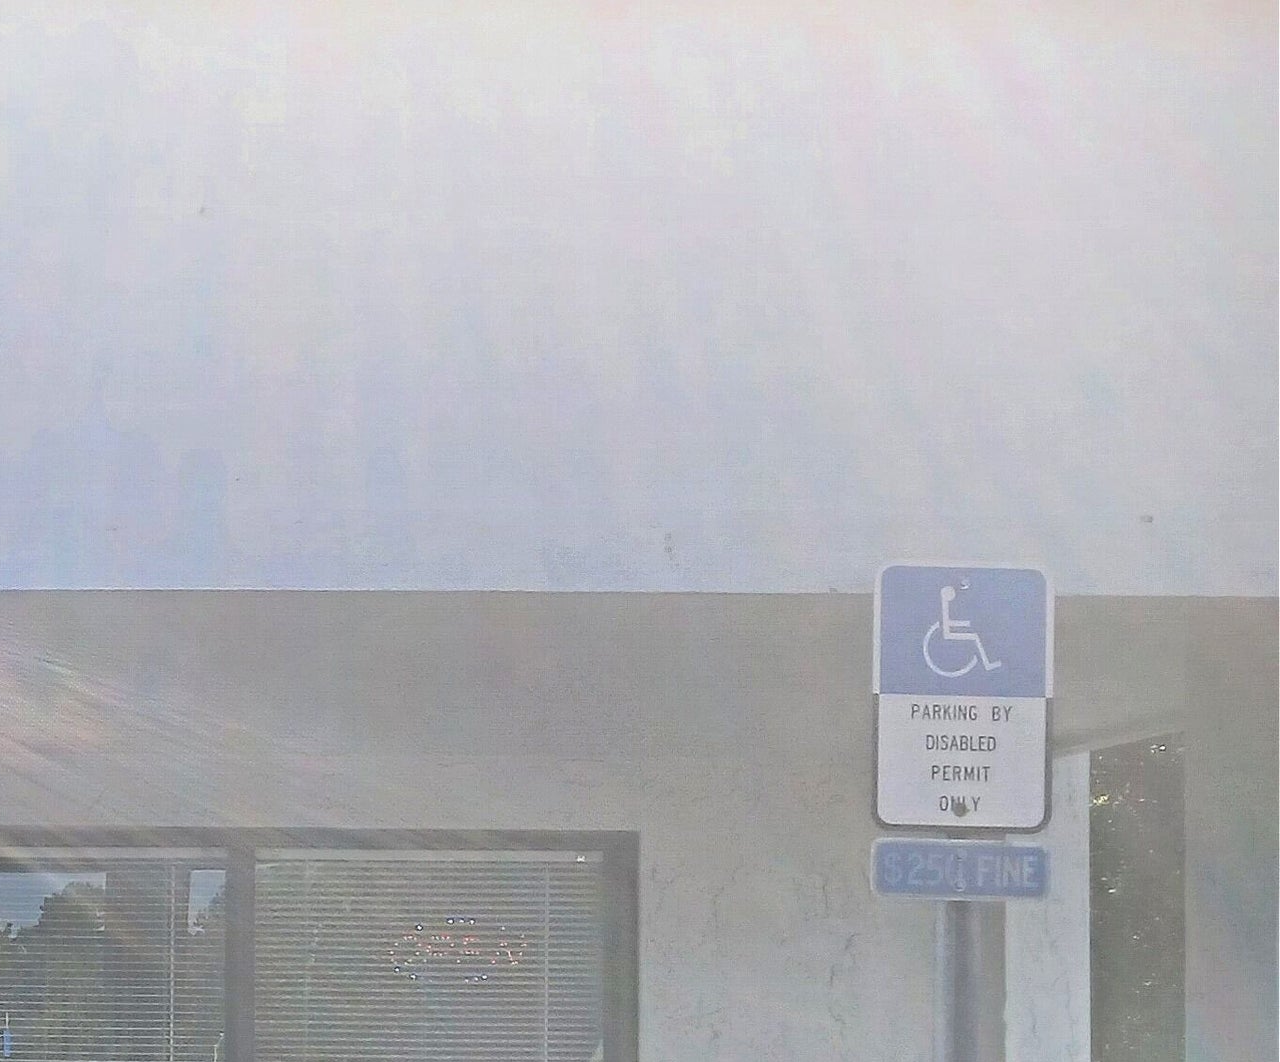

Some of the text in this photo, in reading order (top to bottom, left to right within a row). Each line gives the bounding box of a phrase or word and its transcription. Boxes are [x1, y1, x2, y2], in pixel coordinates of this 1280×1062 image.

[911, 704, 1013, 722] PARKING BY
[925, 735, 997, 752] DISABLED
[931, 765, 991, 782] PERMIT
[977, 855, 1040, 888] FINE
